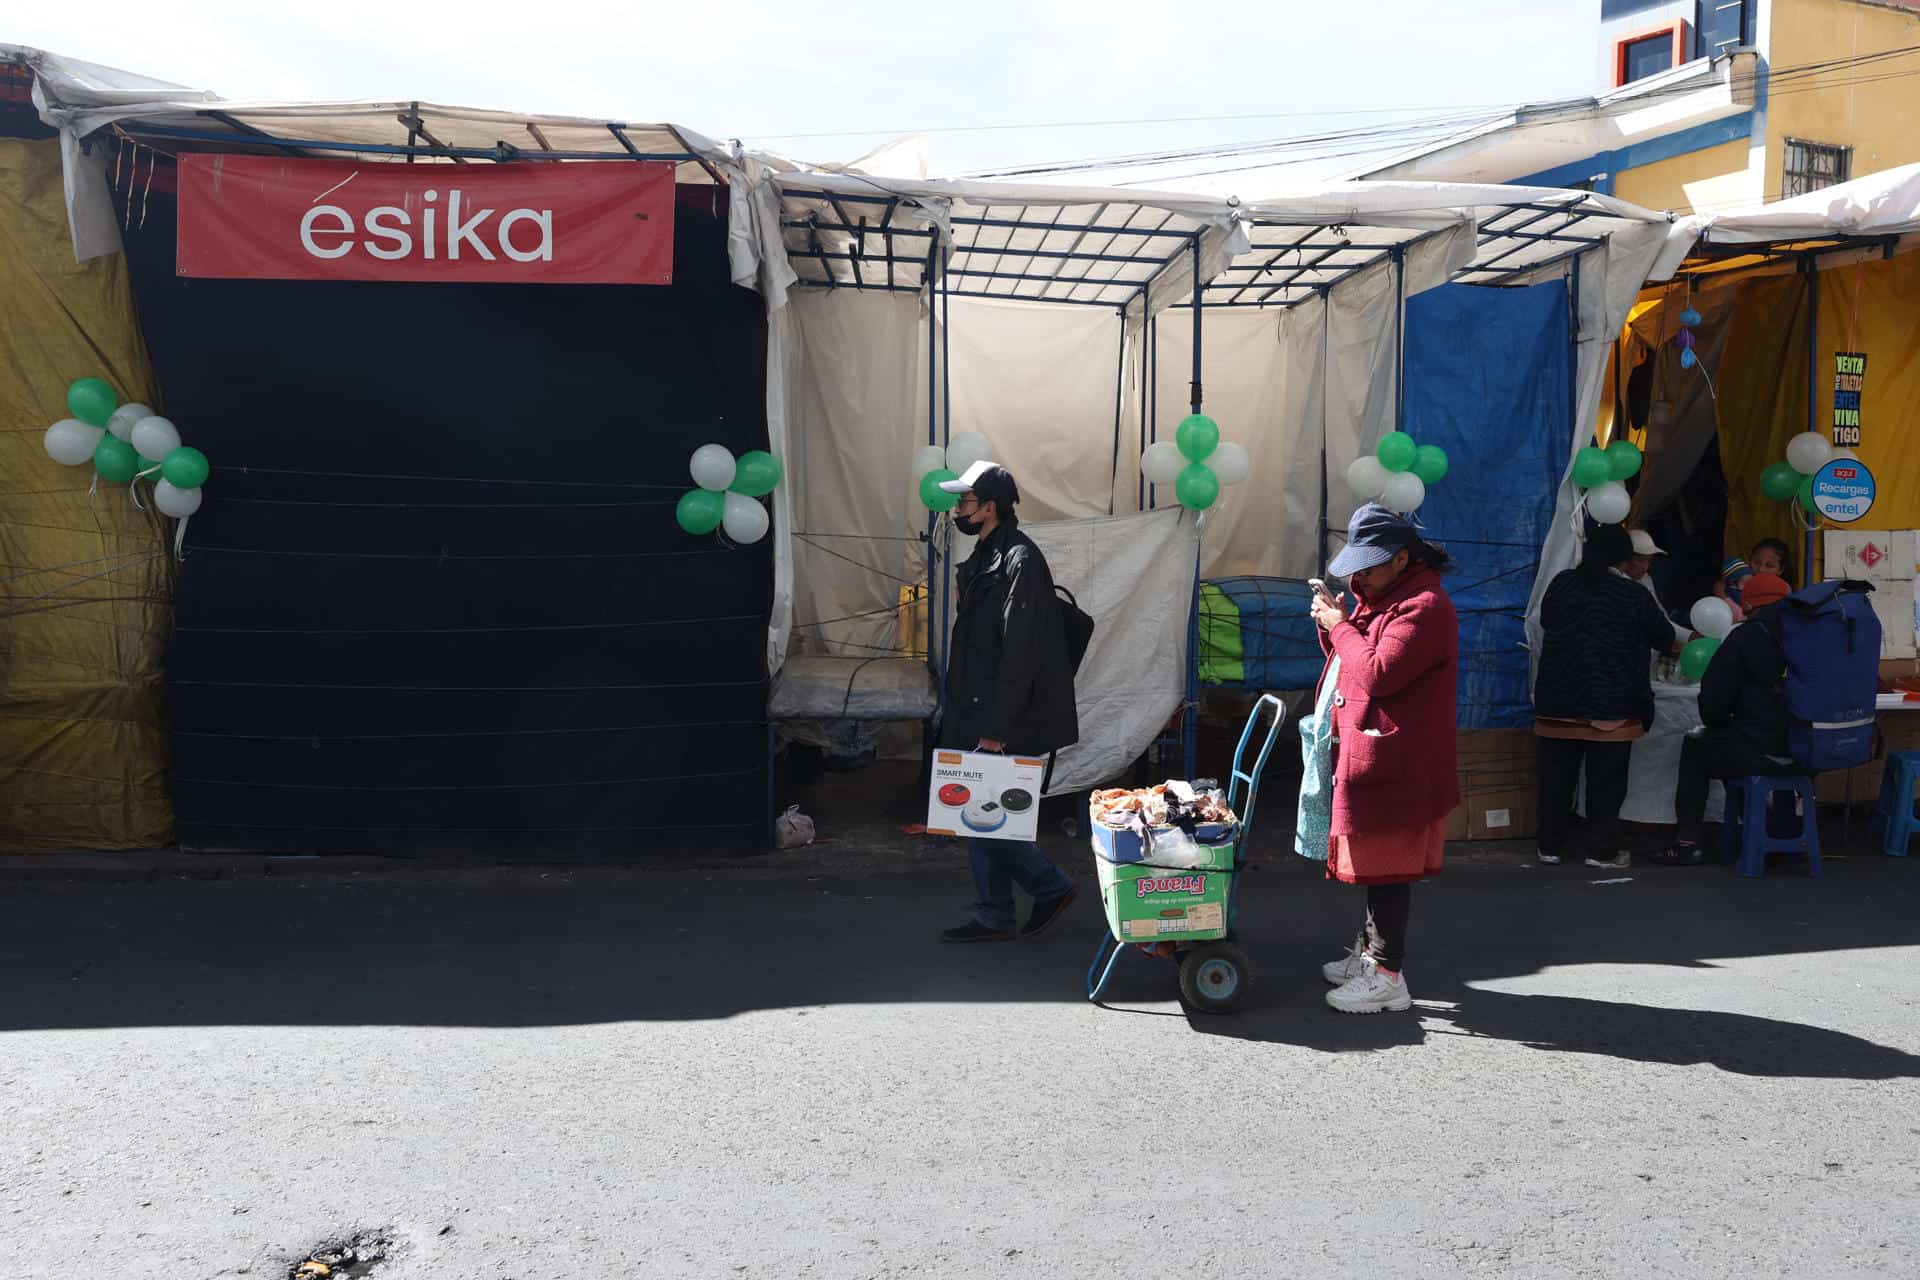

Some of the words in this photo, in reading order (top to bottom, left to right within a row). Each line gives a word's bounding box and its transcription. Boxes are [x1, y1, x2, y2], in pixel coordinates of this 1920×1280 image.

[300, 171, 553, 262] ésika
[1836, 356, 1864, 374] VENTA
[1834, 409, 1859, 426] VIVA
[1833, 427, 1860, 443] TIGO
[1819, 482, 1869, 497] Recargas
[1825, 503, 1860, 515] entel
[936, 769, 962, 777] SMART
[963, 771, 984, 779] MUTE
[1136, 875, 1206, 897] Franci
